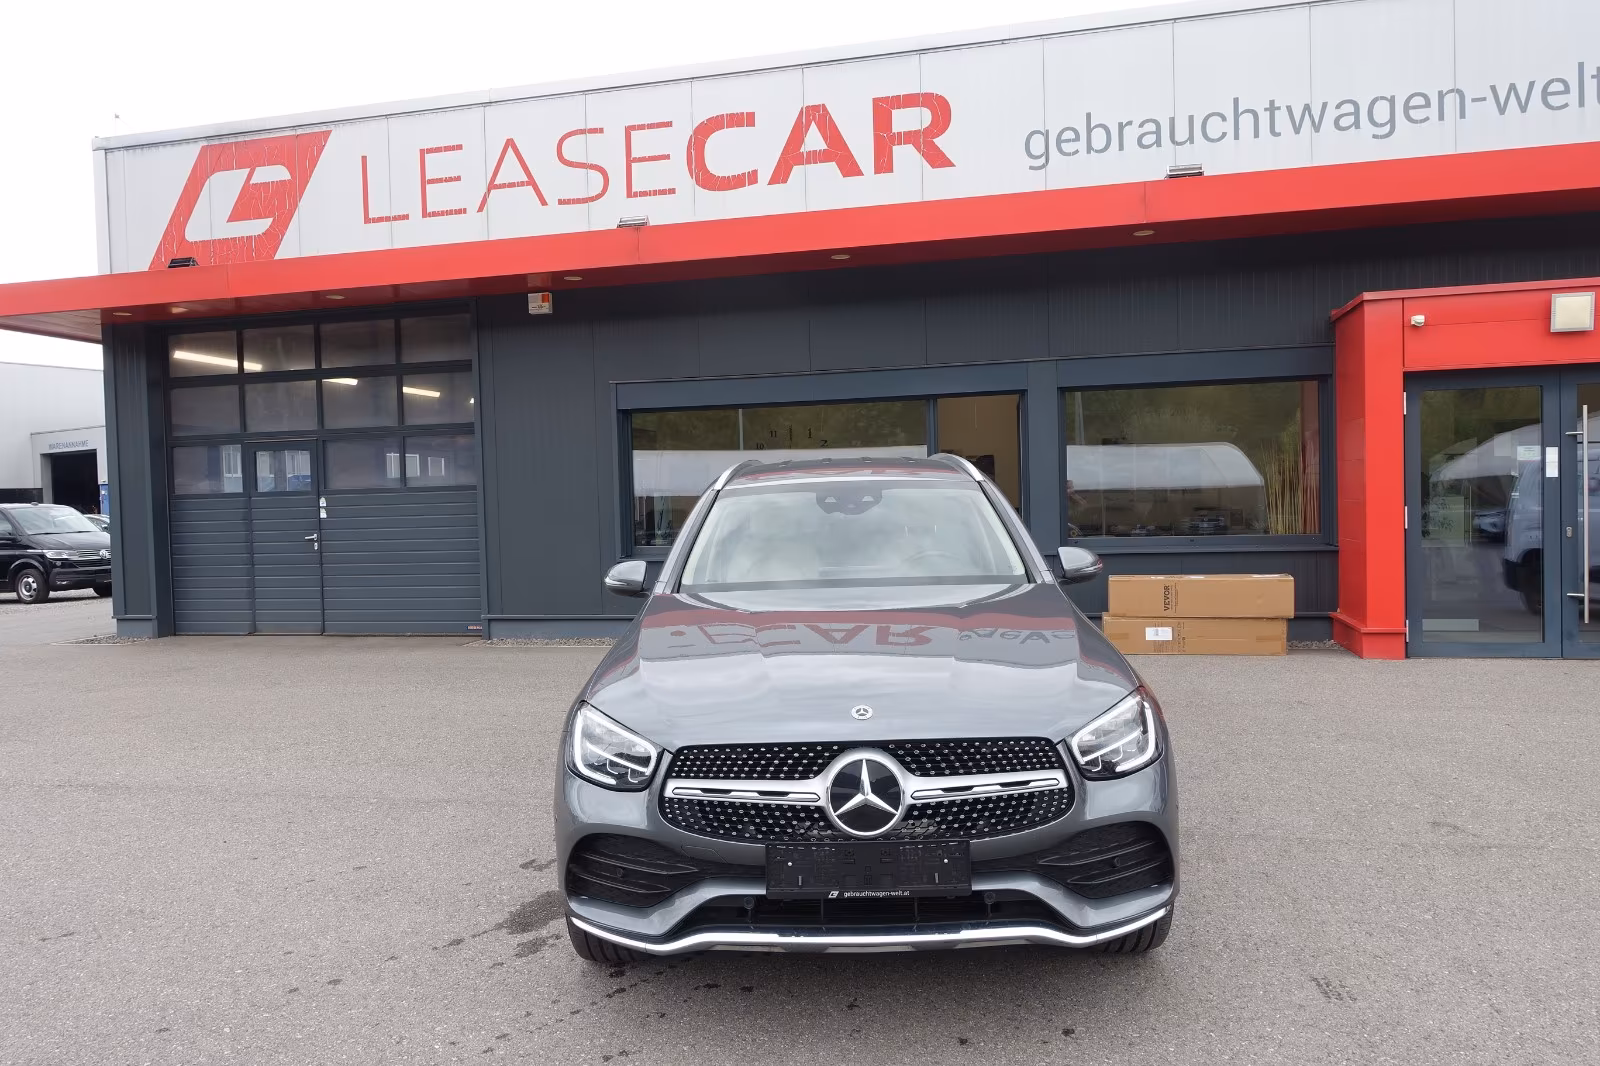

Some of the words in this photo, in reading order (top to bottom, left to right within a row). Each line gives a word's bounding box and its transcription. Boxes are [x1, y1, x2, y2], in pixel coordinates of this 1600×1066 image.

[361, 92, 957, 225] LEASECAR
[1163, 585, 1171, 612] VEVOR
[843, 889, 910, 898] gebrauchtwagen-welt.at
